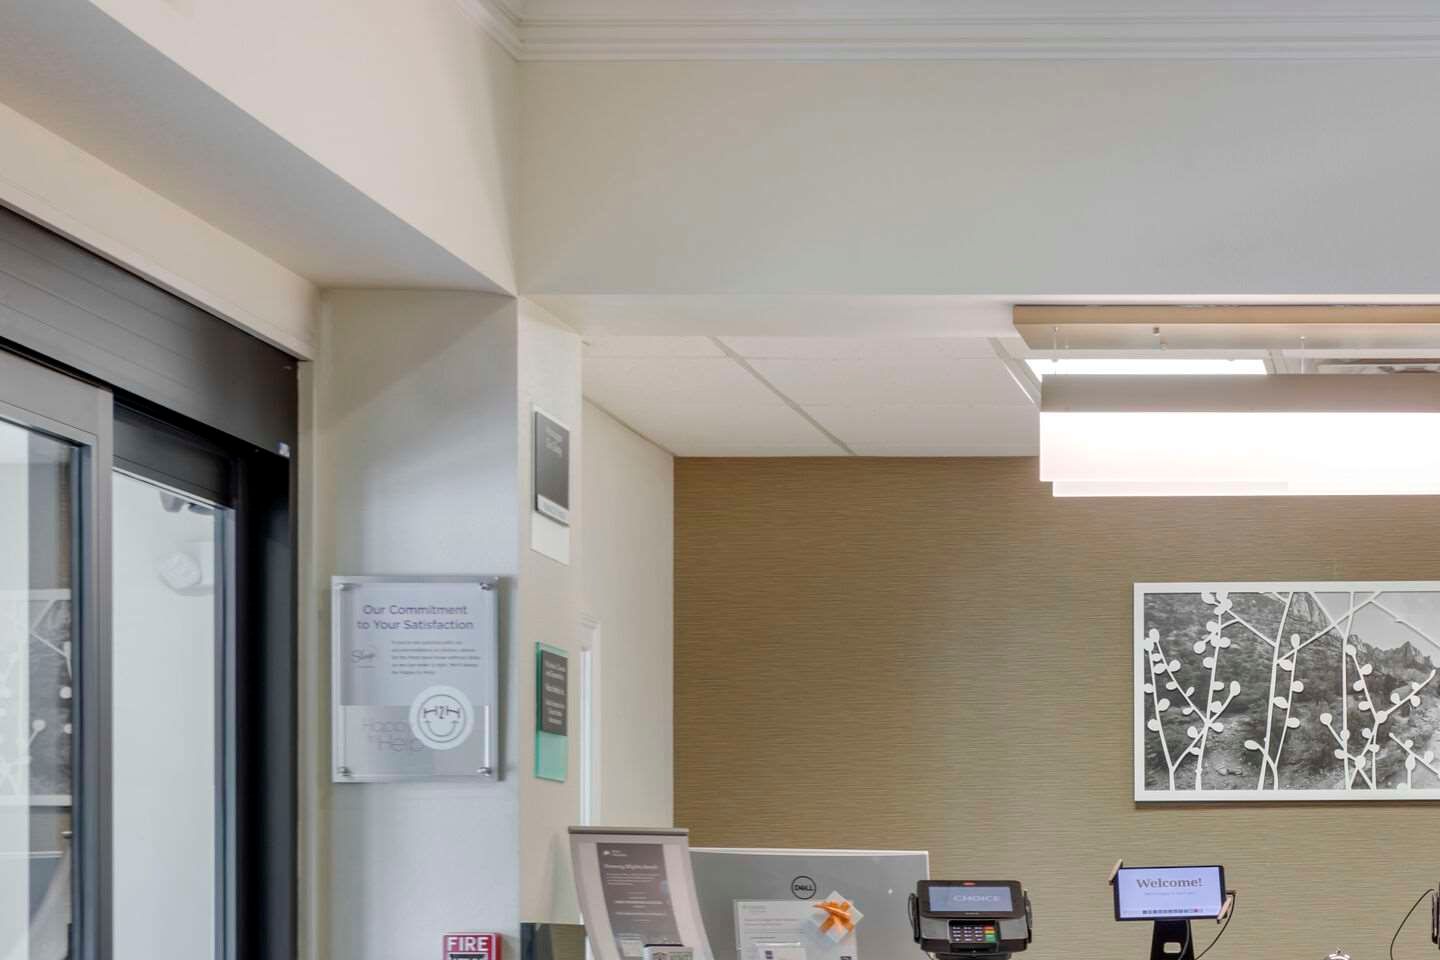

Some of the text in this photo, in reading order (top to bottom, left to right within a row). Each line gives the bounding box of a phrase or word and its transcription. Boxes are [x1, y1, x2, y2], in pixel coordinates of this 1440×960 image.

[362, 604, 468, 615] Our Commitment
[357, 620, 474, 630] to Your Satisfaction
[1136, 877, 1202, 888] Welcome!
[795, 884, 814, 892] DELL
[953, 894, 1001, 902] CHOICE
[447, 936, 489, 952] FIRE
